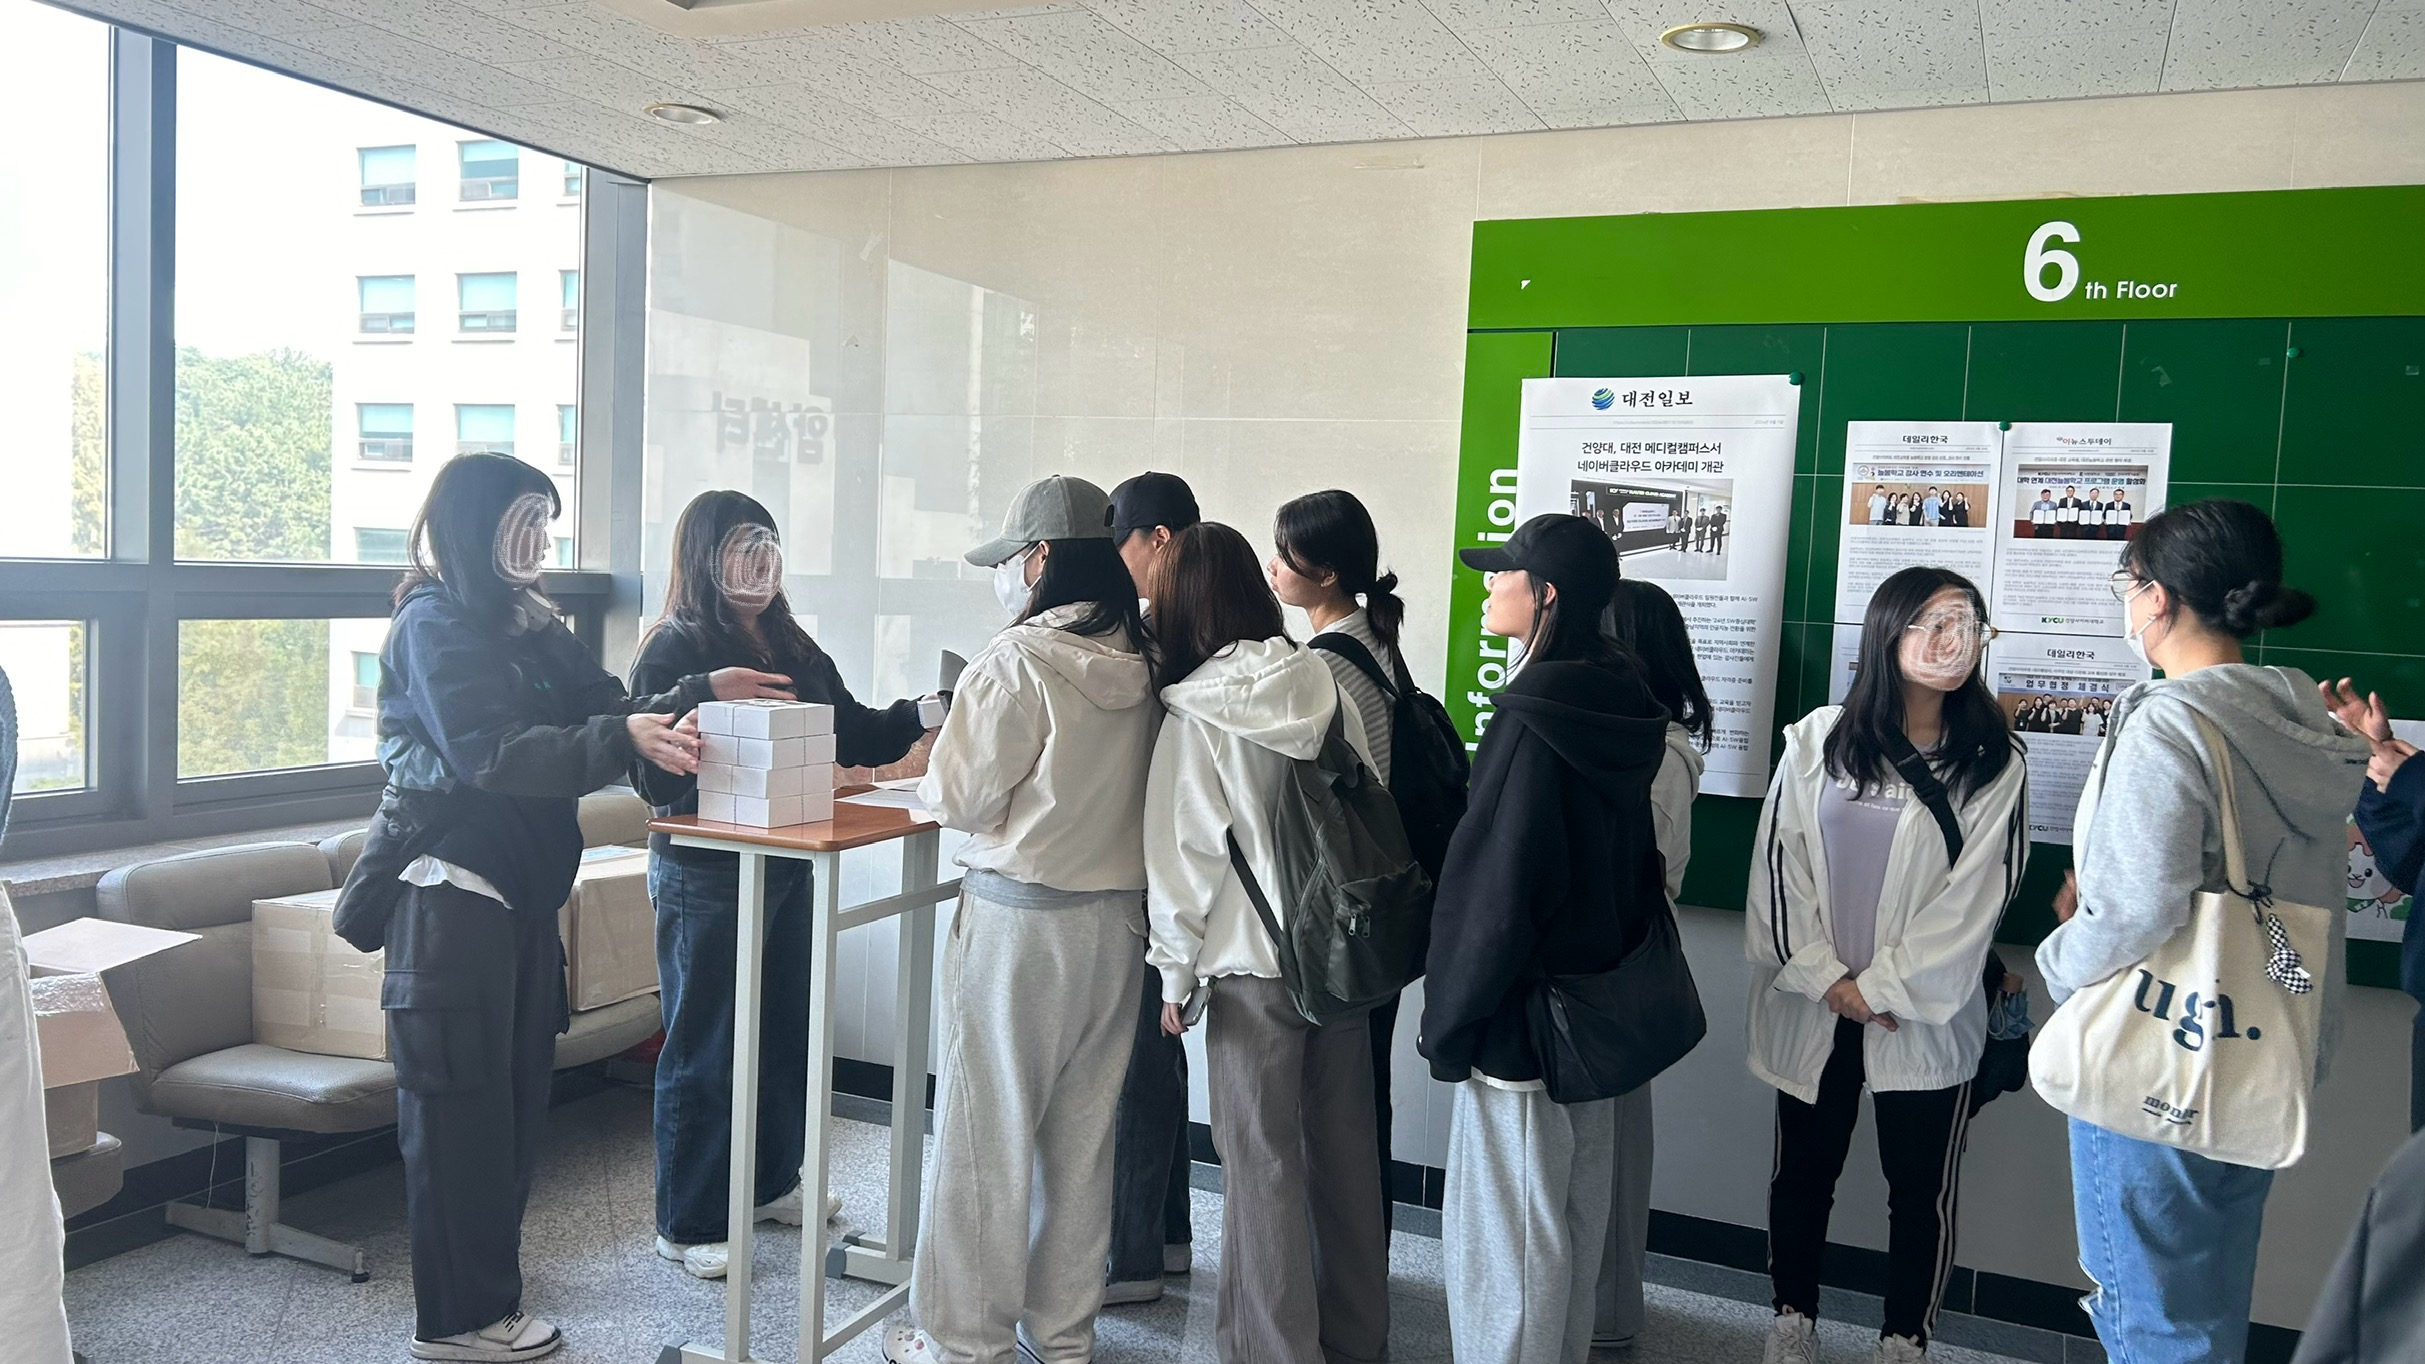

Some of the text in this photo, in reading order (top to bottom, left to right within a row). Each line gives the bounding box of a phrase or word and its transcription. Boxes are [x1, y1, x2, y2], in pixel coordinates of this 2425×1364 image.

[2116, 280, 2177, 299] Floor
[1623, 390, 1693, 408] 대전일보
[1903, 435, 1948, 444] 데일리한국
[2063, 437, 2112, 445] 이뉴스투데이
[1582, 442, 1722, 456] 건양대, 대전 메디컬캠퍼스서
[1577, 460, 1724, 474] 네이버클라우드 아카데미 개관
[1878, 469, 1904, 477] 늘봄학교
[1944, 470, 1984, 478] 오리엔테이션
[2045, 477, 2083, 485] 대전늘봄학교
[2084, 477, 2110, 485] 프로그램
[2047, 649, 2095, 660] 데일리한국
